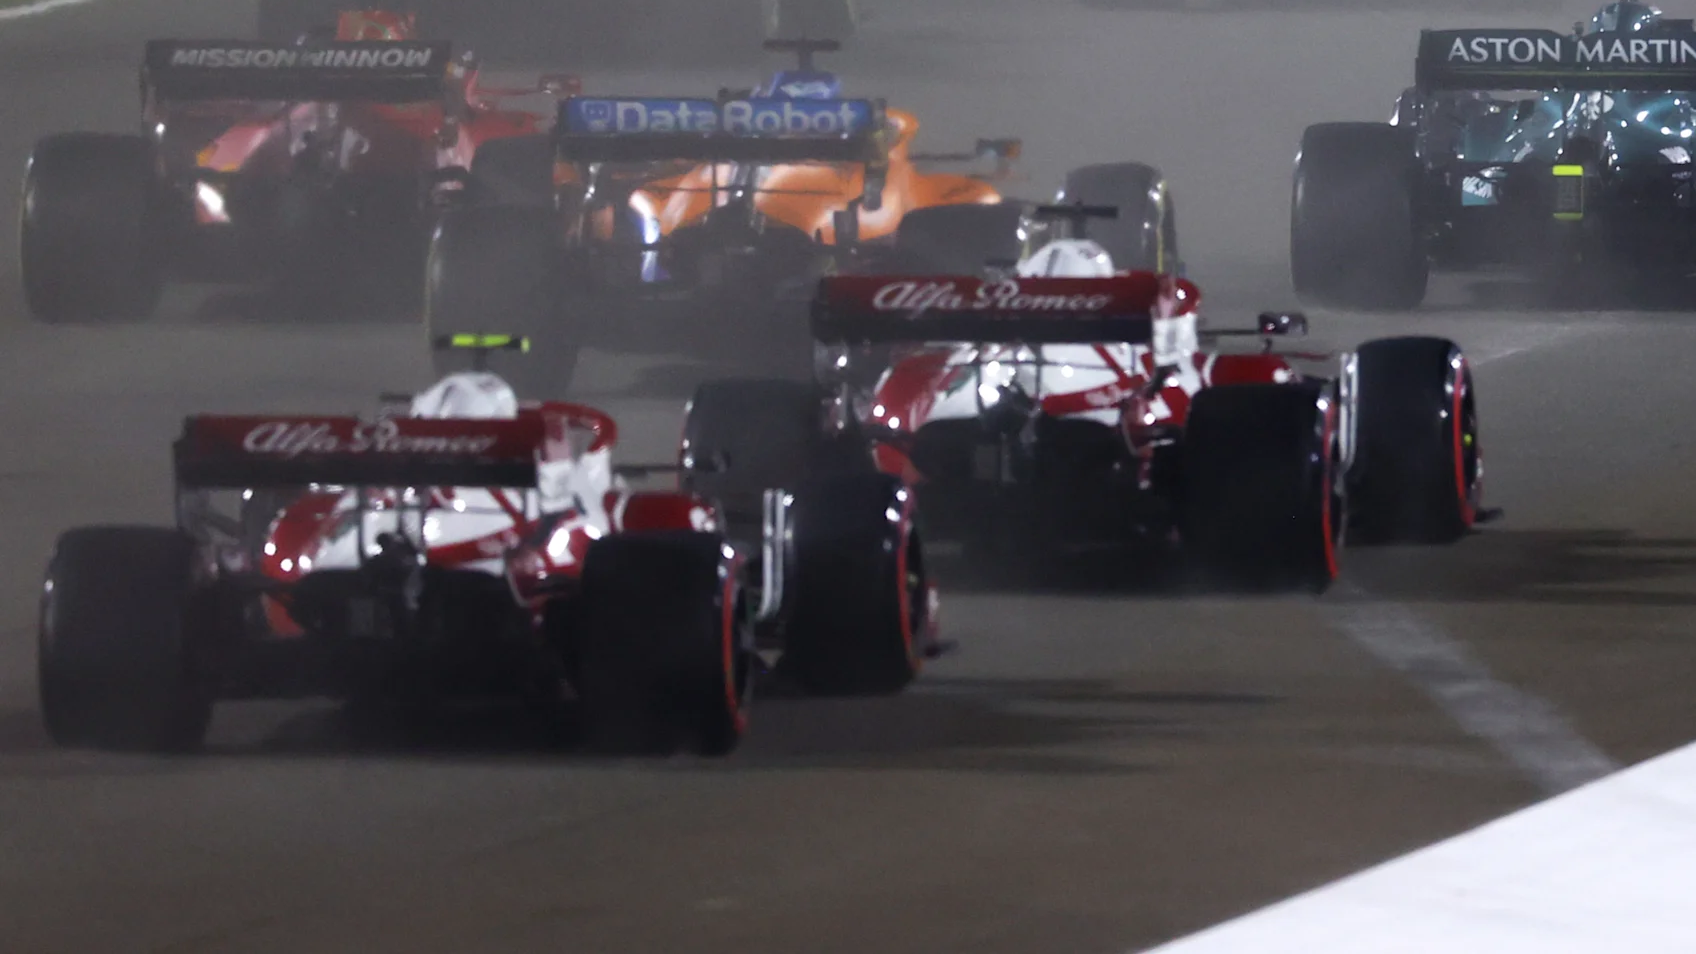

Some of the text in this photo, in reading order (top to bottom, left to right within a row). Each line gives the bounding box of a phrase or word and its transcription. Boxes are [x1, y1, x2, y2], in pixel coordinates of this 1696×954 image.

[171, 47, 432, 69] MISSION WINNOW
[1448, 35, 1561, 64] ASTON
[616, 99, 857, 136] DataRobot
[872, 278, 1115, 322] Alfa Romeo
[242, 413, 498, 459] Alfa Romeo
